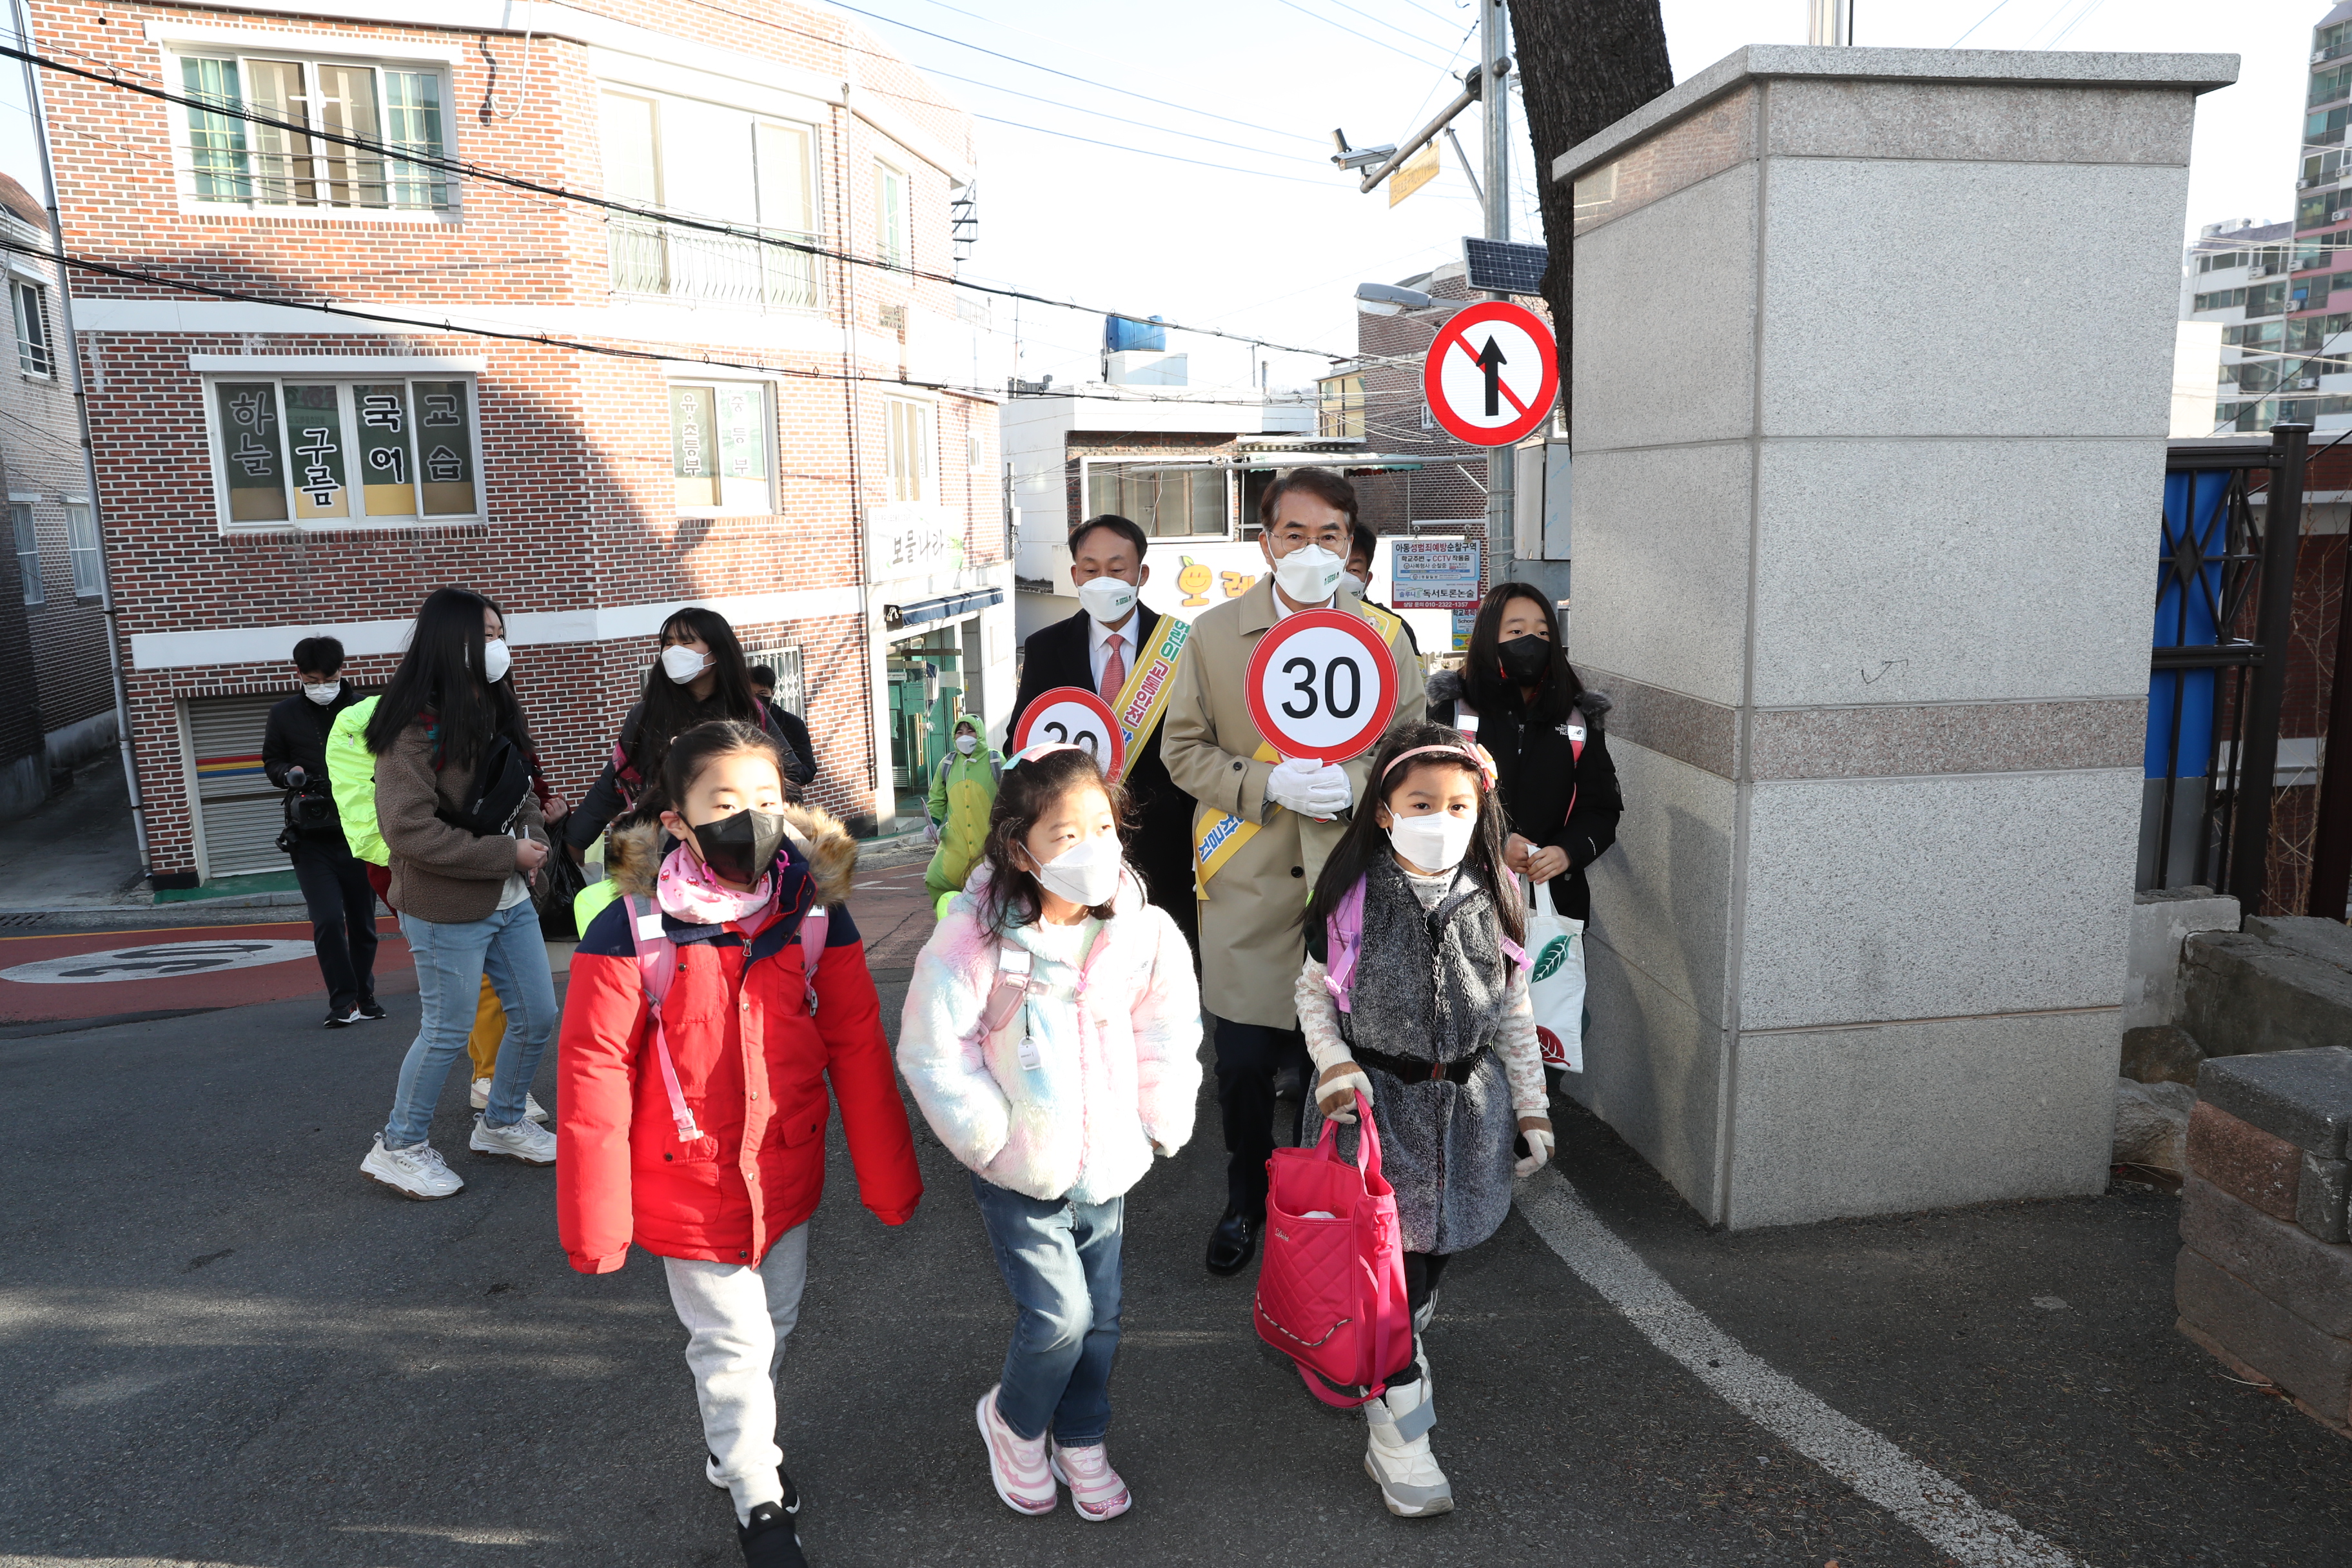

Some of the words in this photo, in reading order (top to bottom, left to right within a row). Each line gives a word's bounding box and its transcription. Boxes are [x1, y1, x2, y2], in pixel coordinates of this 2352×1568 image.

[229, 391, 275, 476] 하늘
[295, 427, 341, 507] 구름
[362, 395, 405, 484] 국어
[424, 394, 462, 482] 교습
[892, 528, 945, 565] 보물나라
[1423, 589, 1475, 598] 독서토론논술
[1122, 659, 1170, 729] 교통안전
[1281, 656, 1361, 719] 30
